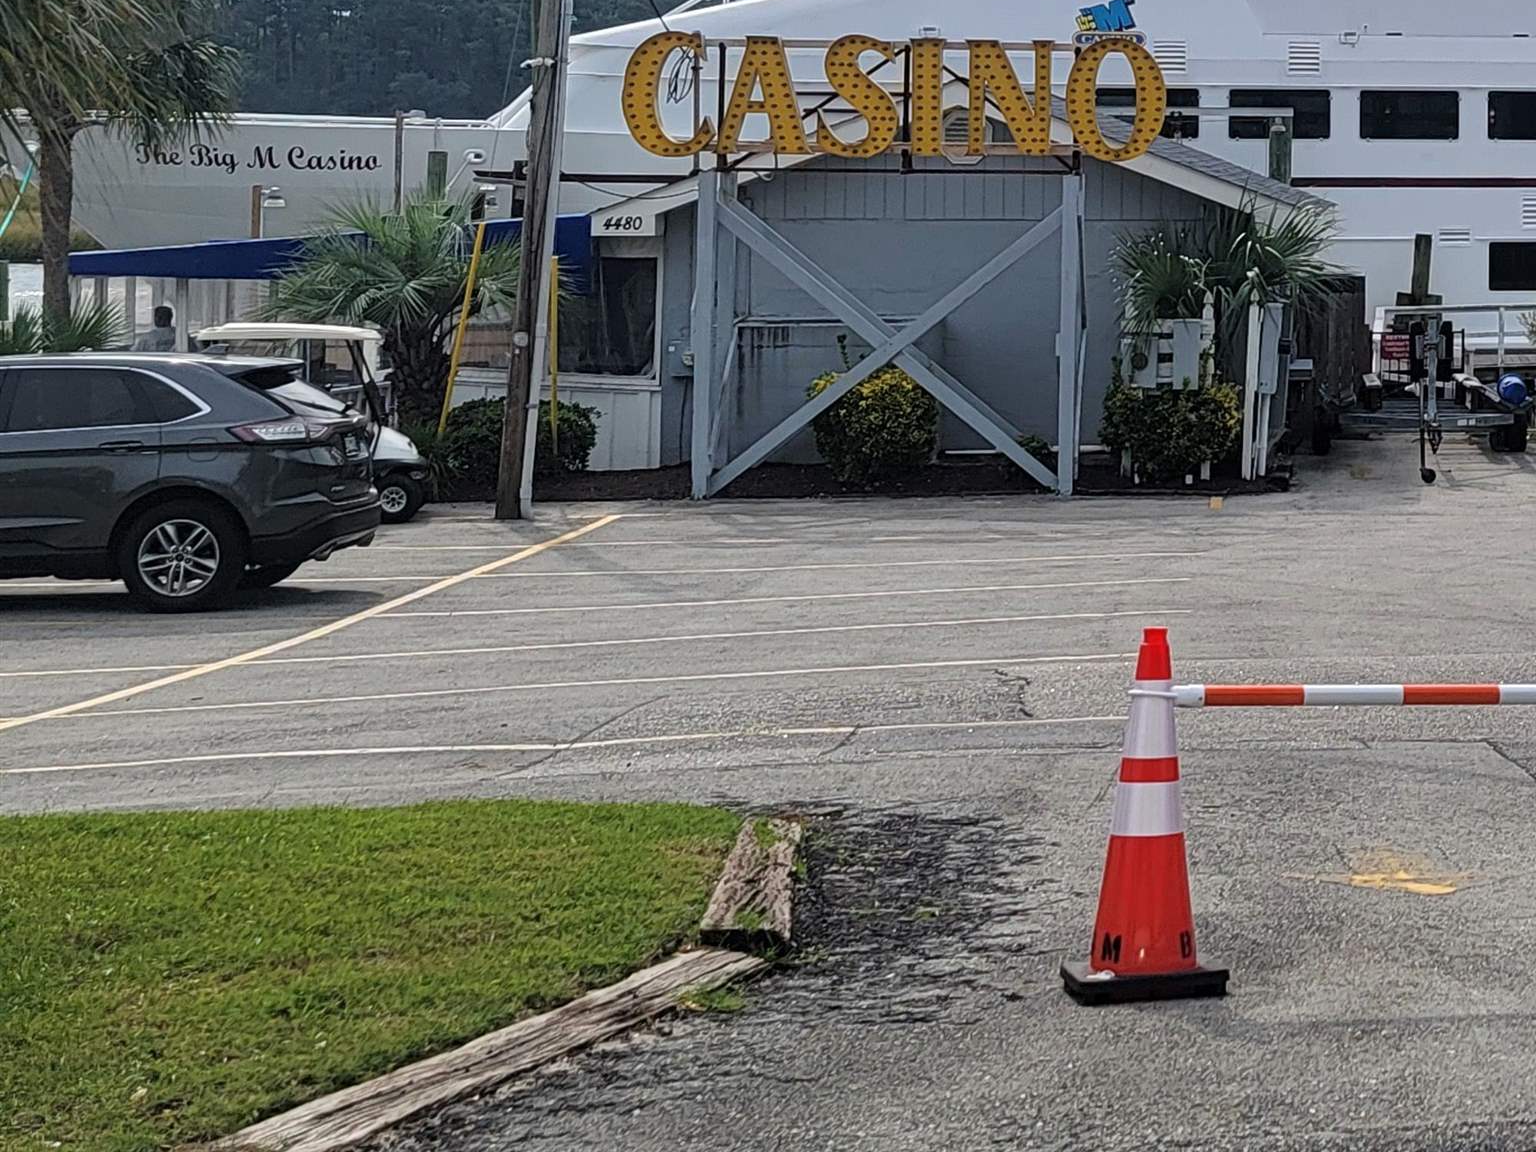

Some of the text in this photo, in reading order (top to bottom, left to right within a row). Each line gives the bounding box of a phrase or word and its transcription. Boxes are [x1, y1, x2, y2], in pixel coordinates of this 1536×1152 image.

[621, 30, 1168, 162] CASINO
[135, 142, 382, 174] The Big M Casino
[602, 215, 643, 231] 4480
[1101, 932, 1122, 964] M
